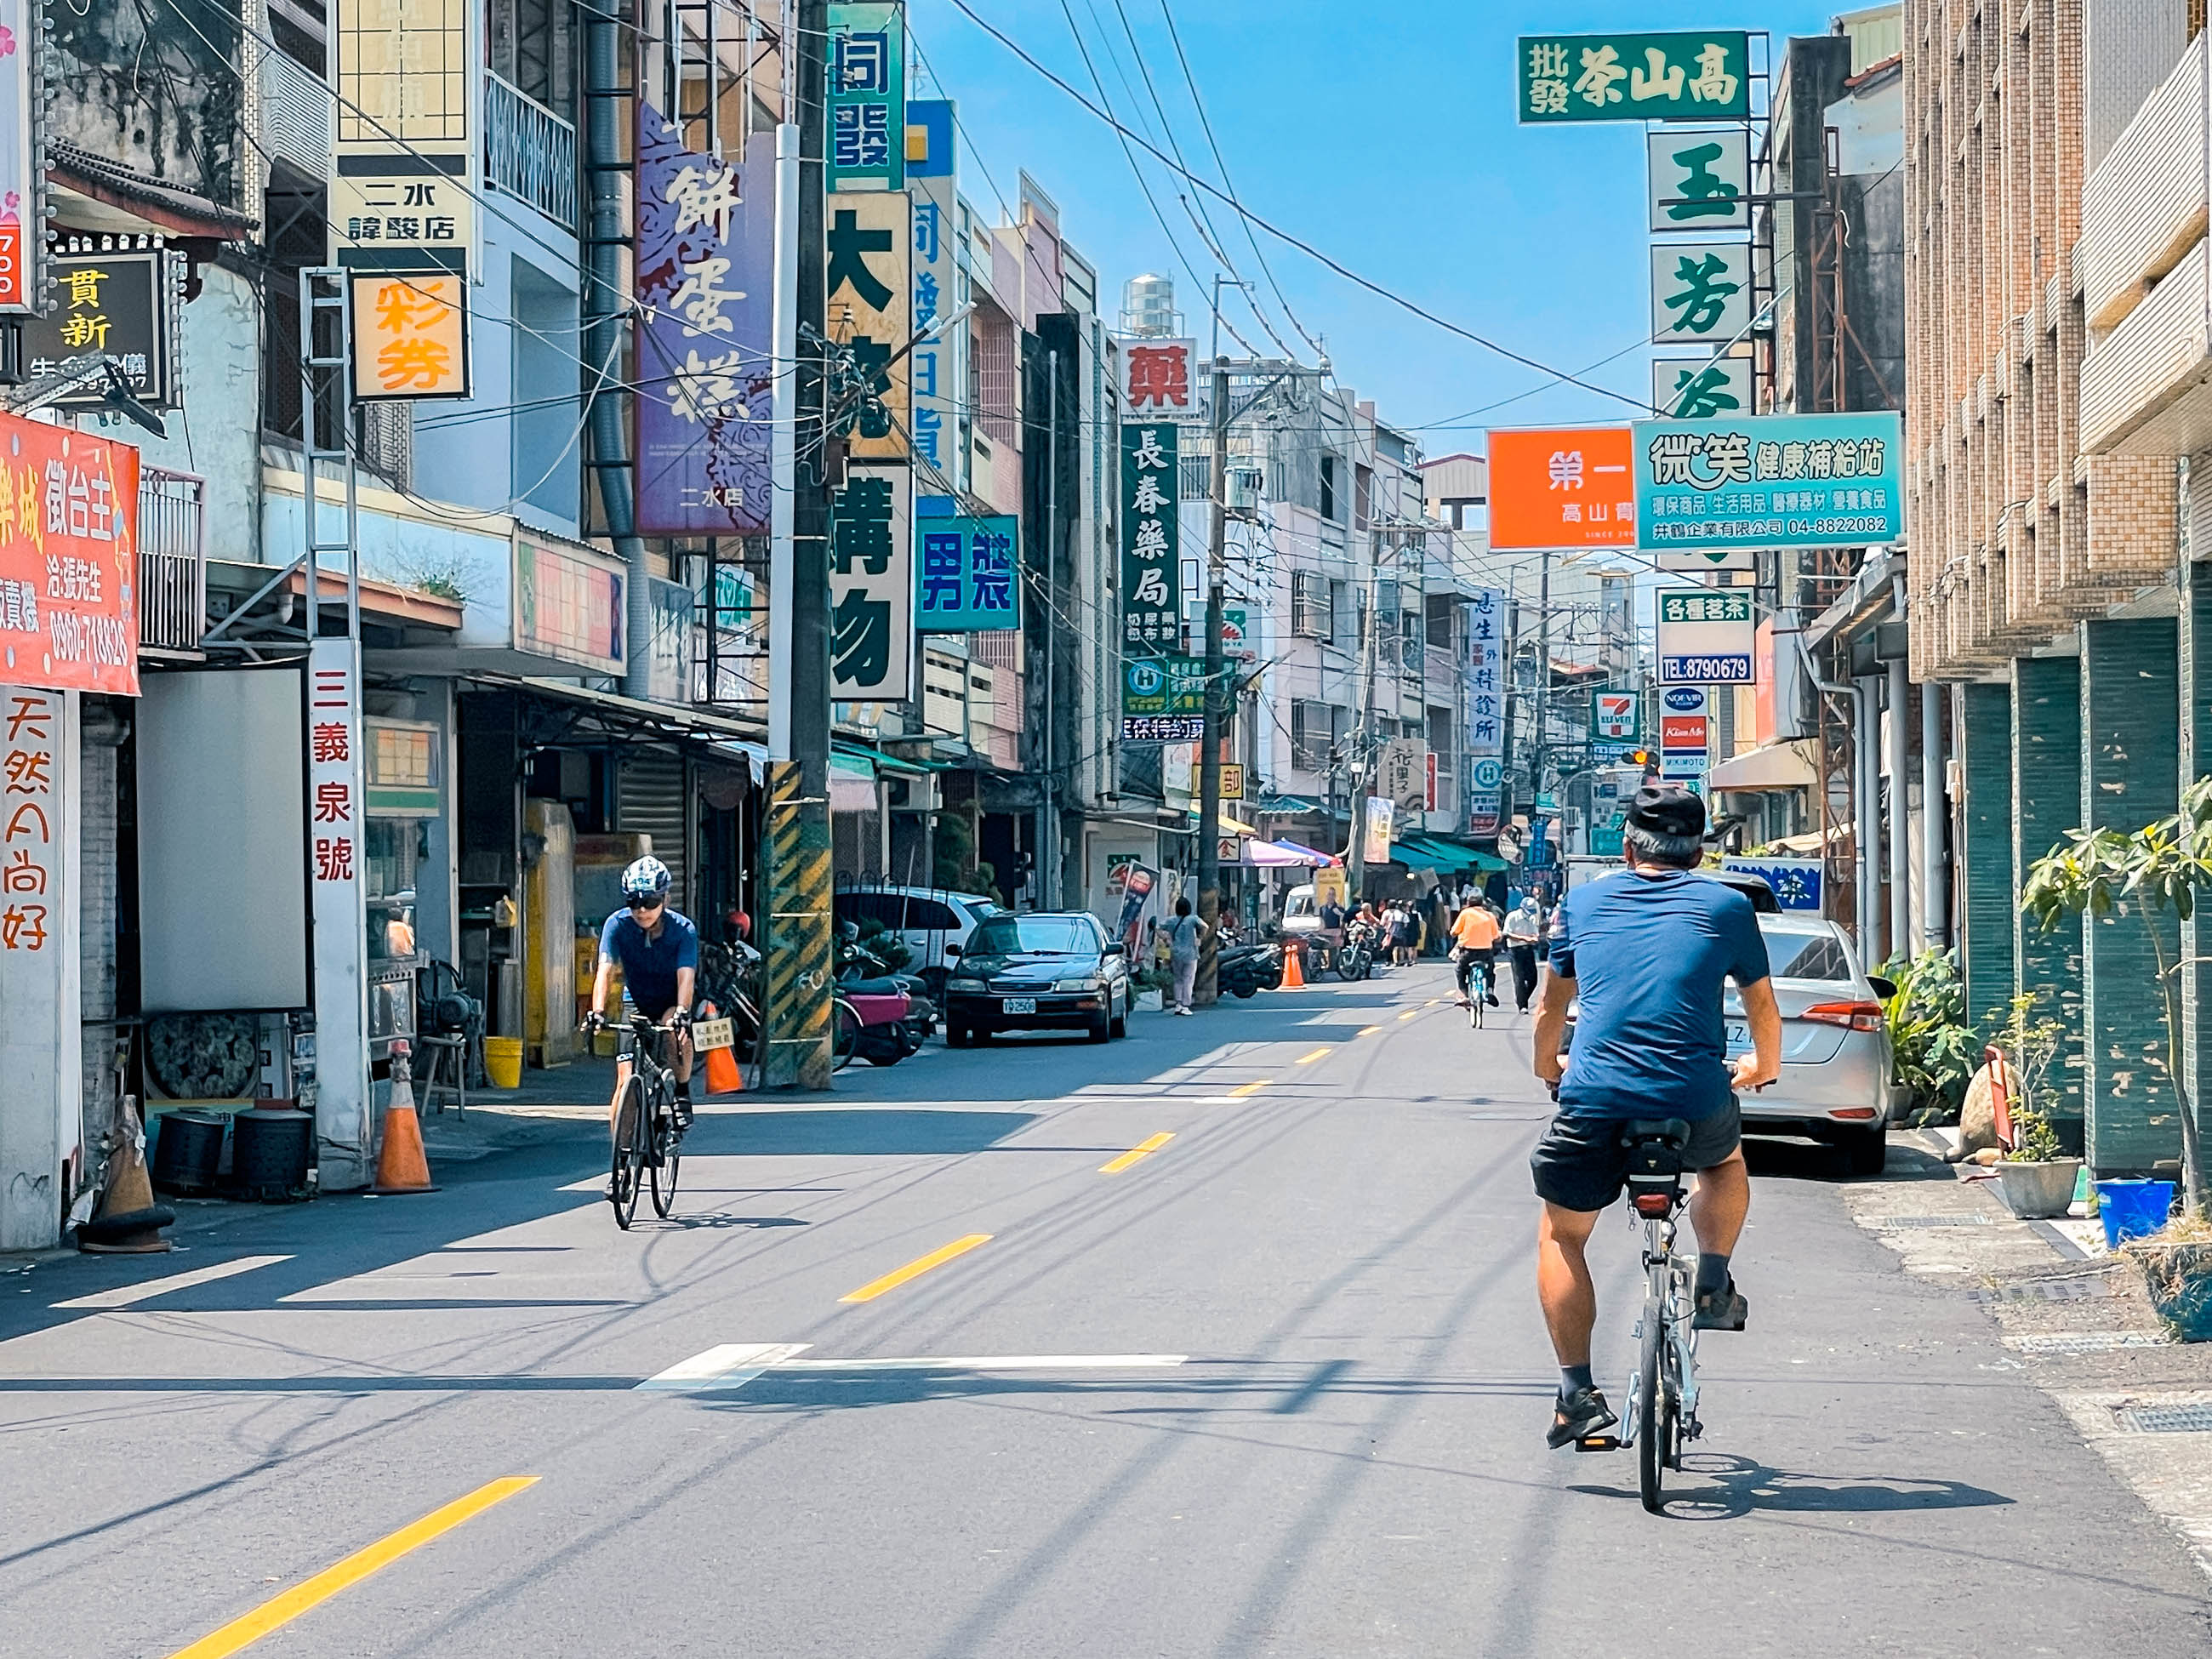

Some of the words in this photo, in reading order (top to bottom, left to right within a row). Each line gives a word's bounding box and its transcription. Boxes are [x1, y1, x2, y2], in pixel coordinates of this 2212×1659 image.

[834, 31, 890, 168] 同發
[1528, 43, 1569, 115] 批發
[1573, 43, 1738, 107] 高山茶
[365, 184, 435, 207] 二水
[59, 270, 111, 350] 貫新
[666, 165, 750, 424] 餅蛋糕
[377, 282, 451, 390] 彩券
[1127, 345, 1188, 407] 藥
[1548, 450, 1627, 491] 第一
[1650, 432, 1751, 491] 微笑
[1755, 437, 1885, 482] 健康補給站
[45, 458, 111, 541] 徵台主
[680, 487, 743, 507] 二水店
[1132, 429, 1170, 607] 長春藥局
[1788, 516, 1886, 535] 04-8822082
[922, 532, 1012, 612] 男裝
[0, 579, 40, 633] 賣機
[1666, 598, 1744, 621] 各種茗茶
[49, 611, 128, 666] 0960-718826
[1664, 658, 1747, 679] TEL:8790679
[1601, 715, 1631, 724] ELEVEN
[312, 670, 352, 882] 三義泉號
